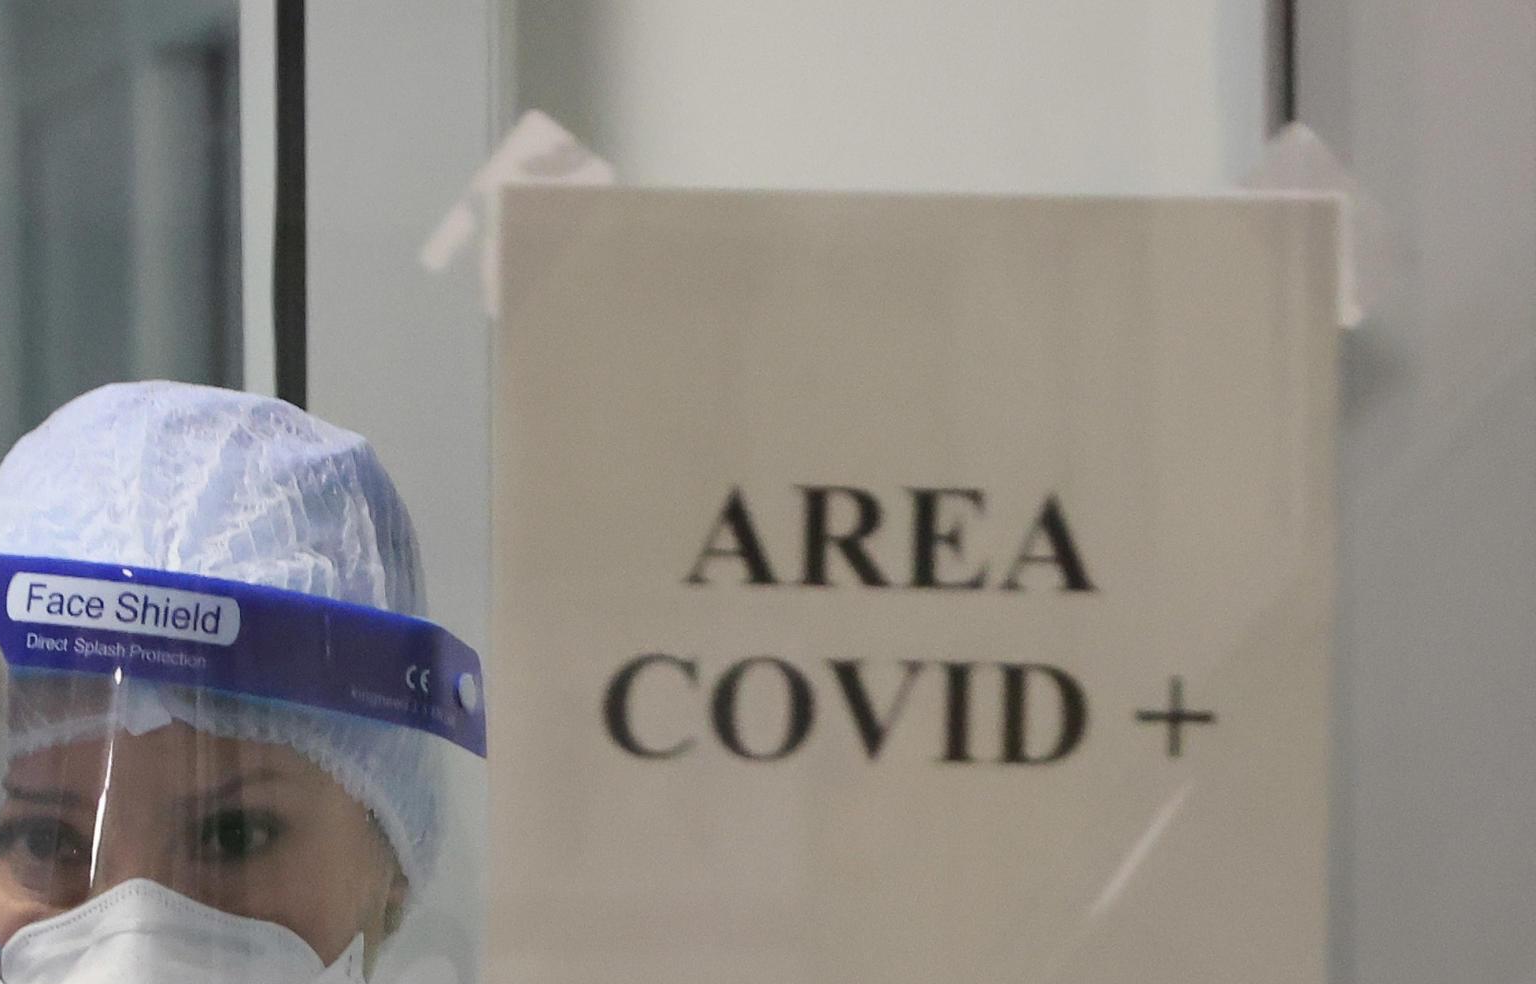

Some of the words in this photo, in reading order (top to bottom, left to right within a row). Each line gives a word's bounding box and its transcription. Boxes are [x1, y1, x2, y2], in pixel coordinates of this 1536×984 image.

[683, 485, 1099, 593] AREA
[26, 583, 104, 619] Face
[115, 592, 221, 635] Shield
[26, 632, 68, 652] Direct
[74, 637, 125, 657] Splash
[129, 645, 207, 669] Protection
[602, 652, 1089, 766] COVID
[1134, 674, 1217, 758] +
